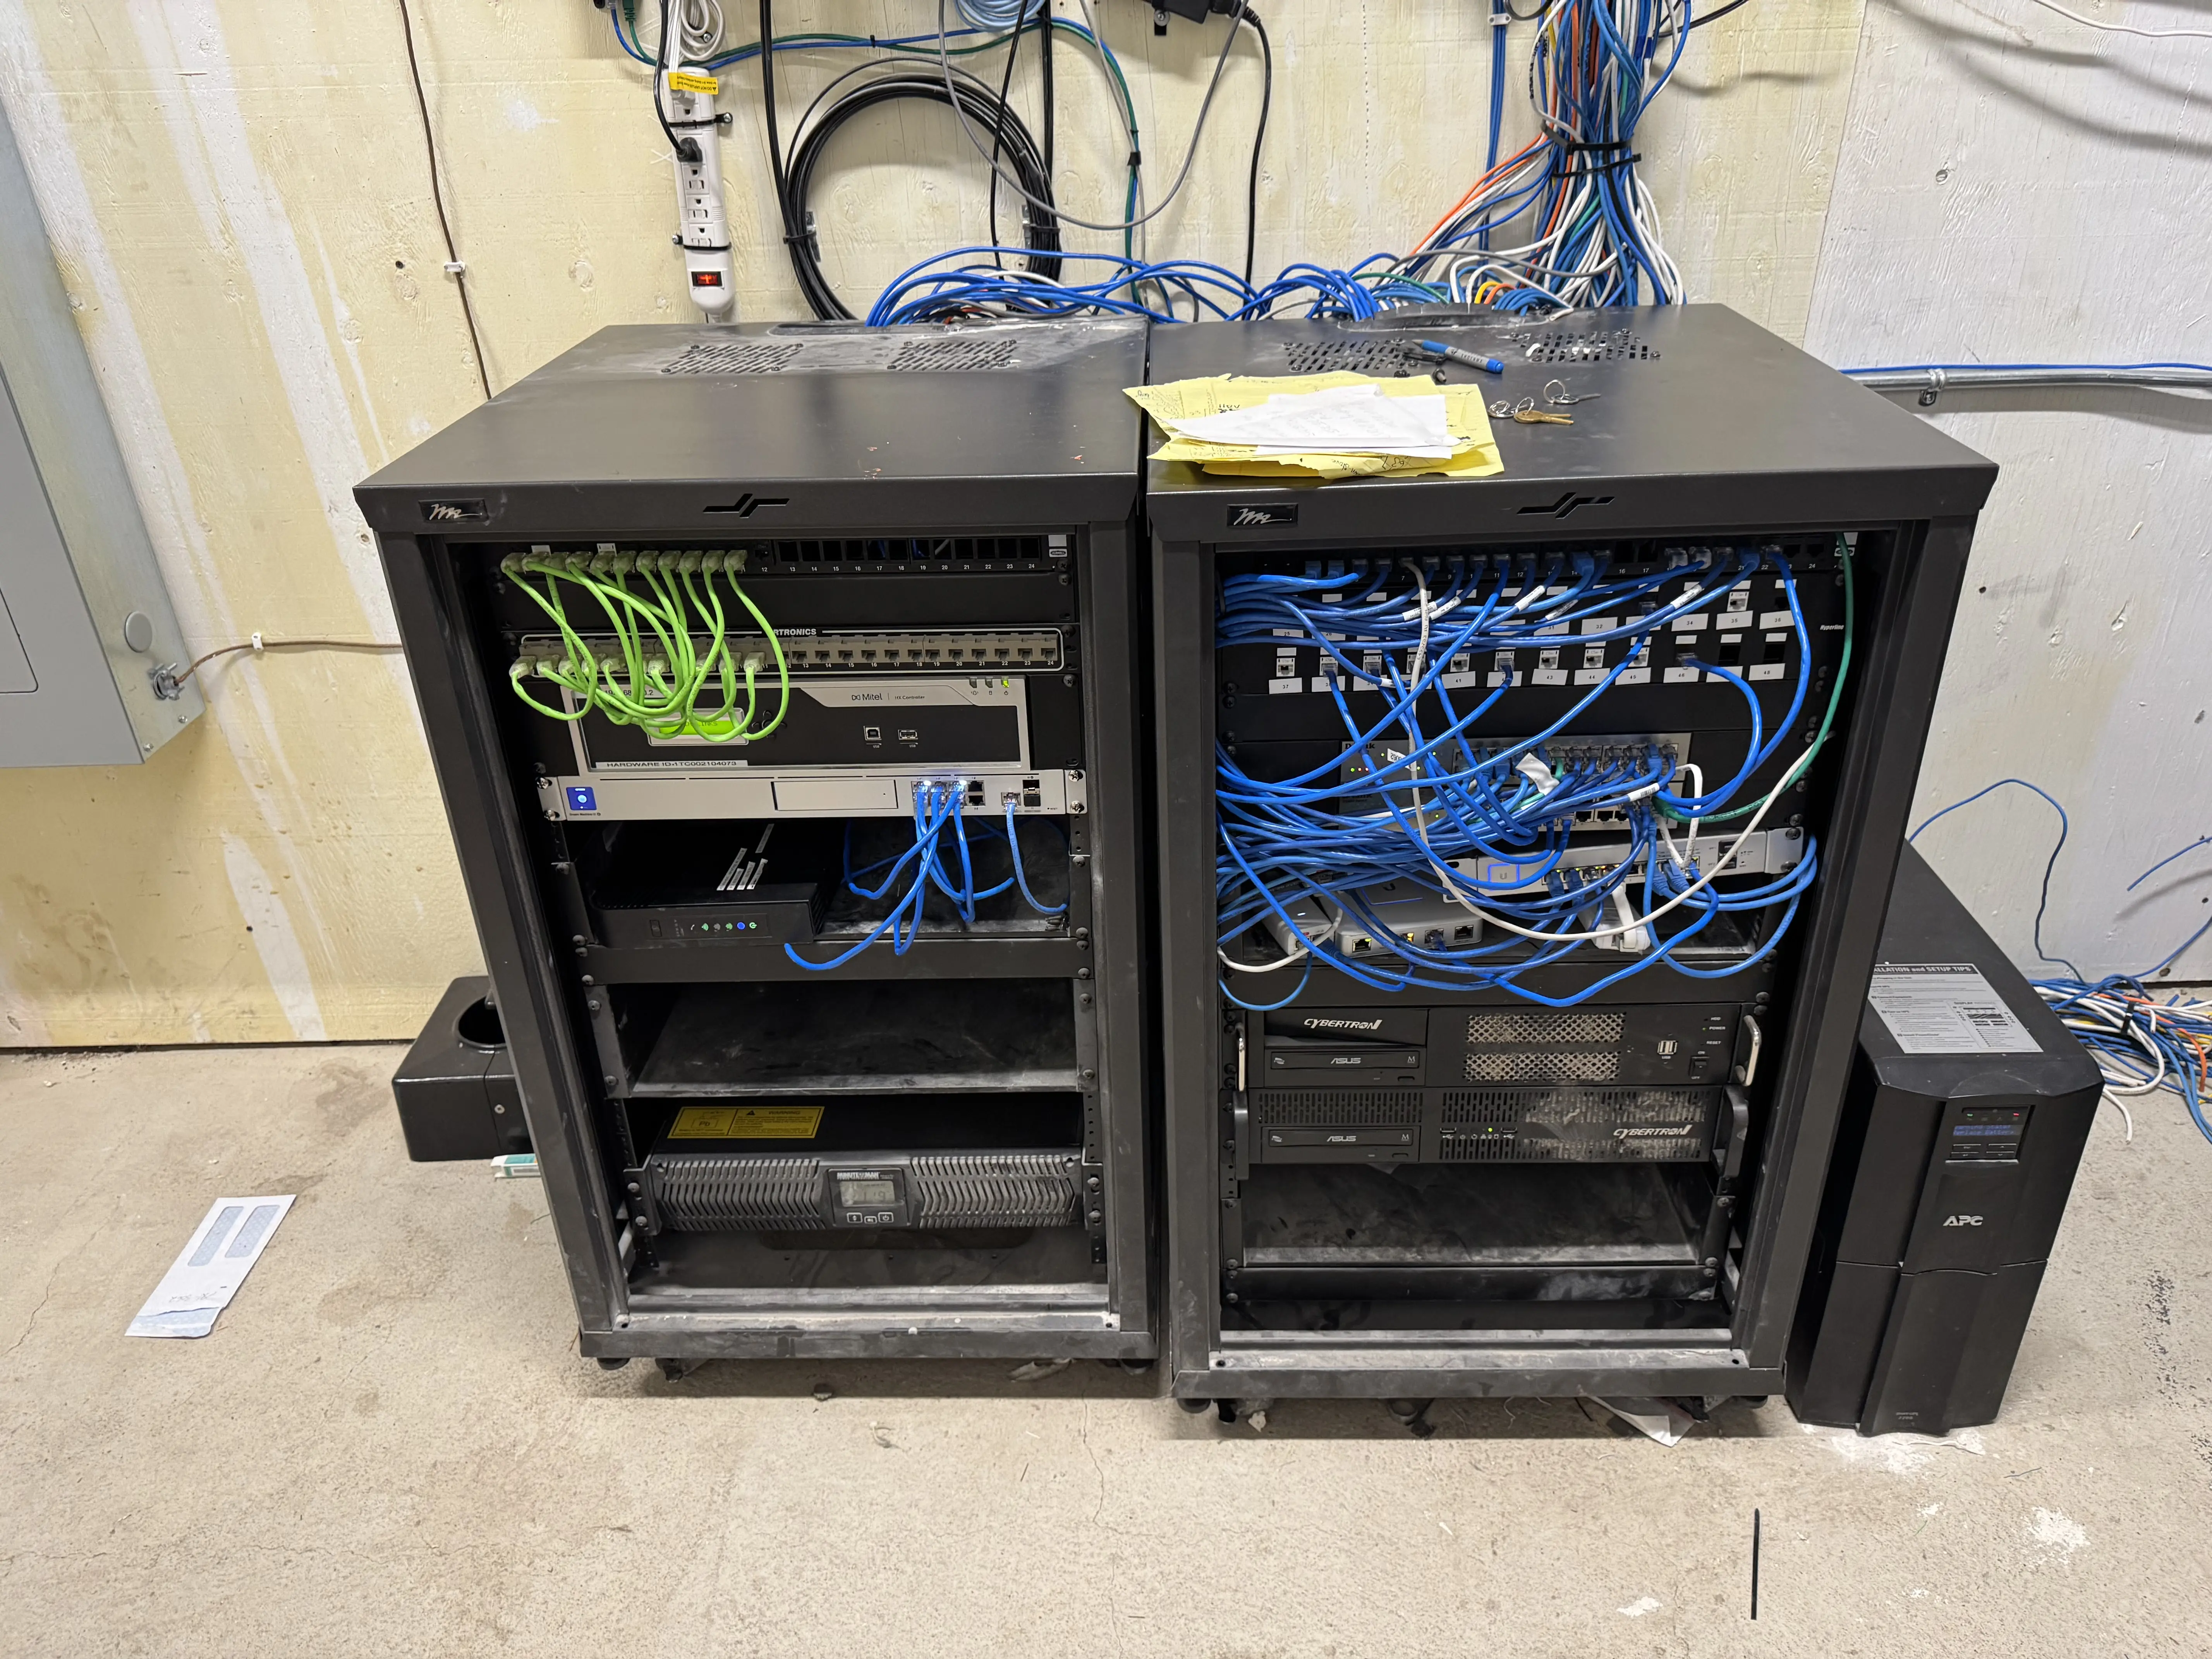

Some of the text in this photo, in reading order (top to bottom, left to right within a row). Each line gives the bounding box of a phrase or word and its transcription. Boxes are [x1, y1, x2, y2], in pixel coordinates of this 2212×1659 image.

[1304, 1018, 1382, 1030] CYBERTRON
[1613, 1125, 1693, 1139] CYBERTRON
[1943, 1215, 1984, 1226] APC
